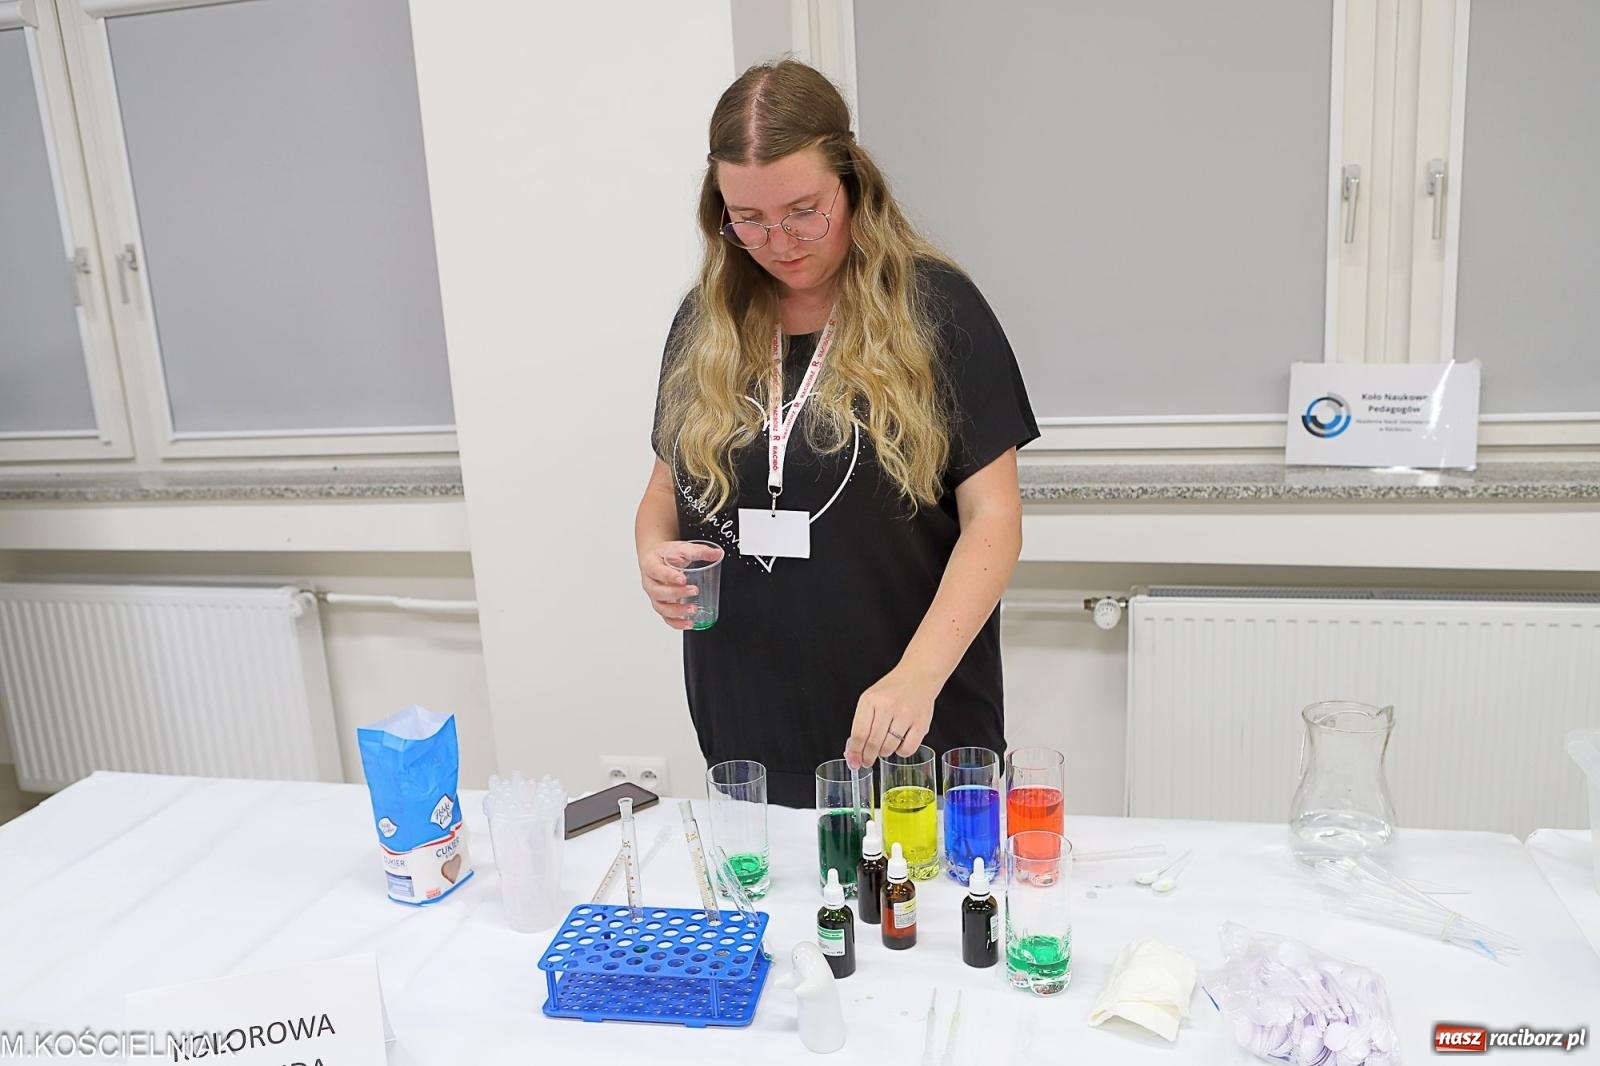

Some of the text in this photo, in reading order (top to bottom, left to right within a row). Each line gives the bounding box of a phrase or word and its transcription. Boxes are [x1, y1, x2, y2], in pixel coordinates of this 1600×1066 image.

[1368, 405, 1421, 414] Pedagogów
[772, 446, 780, 472] RACIBÓ
[720, 520, 741, 549] lov
[174, 1013, 335, 1062] KOLOROWA
